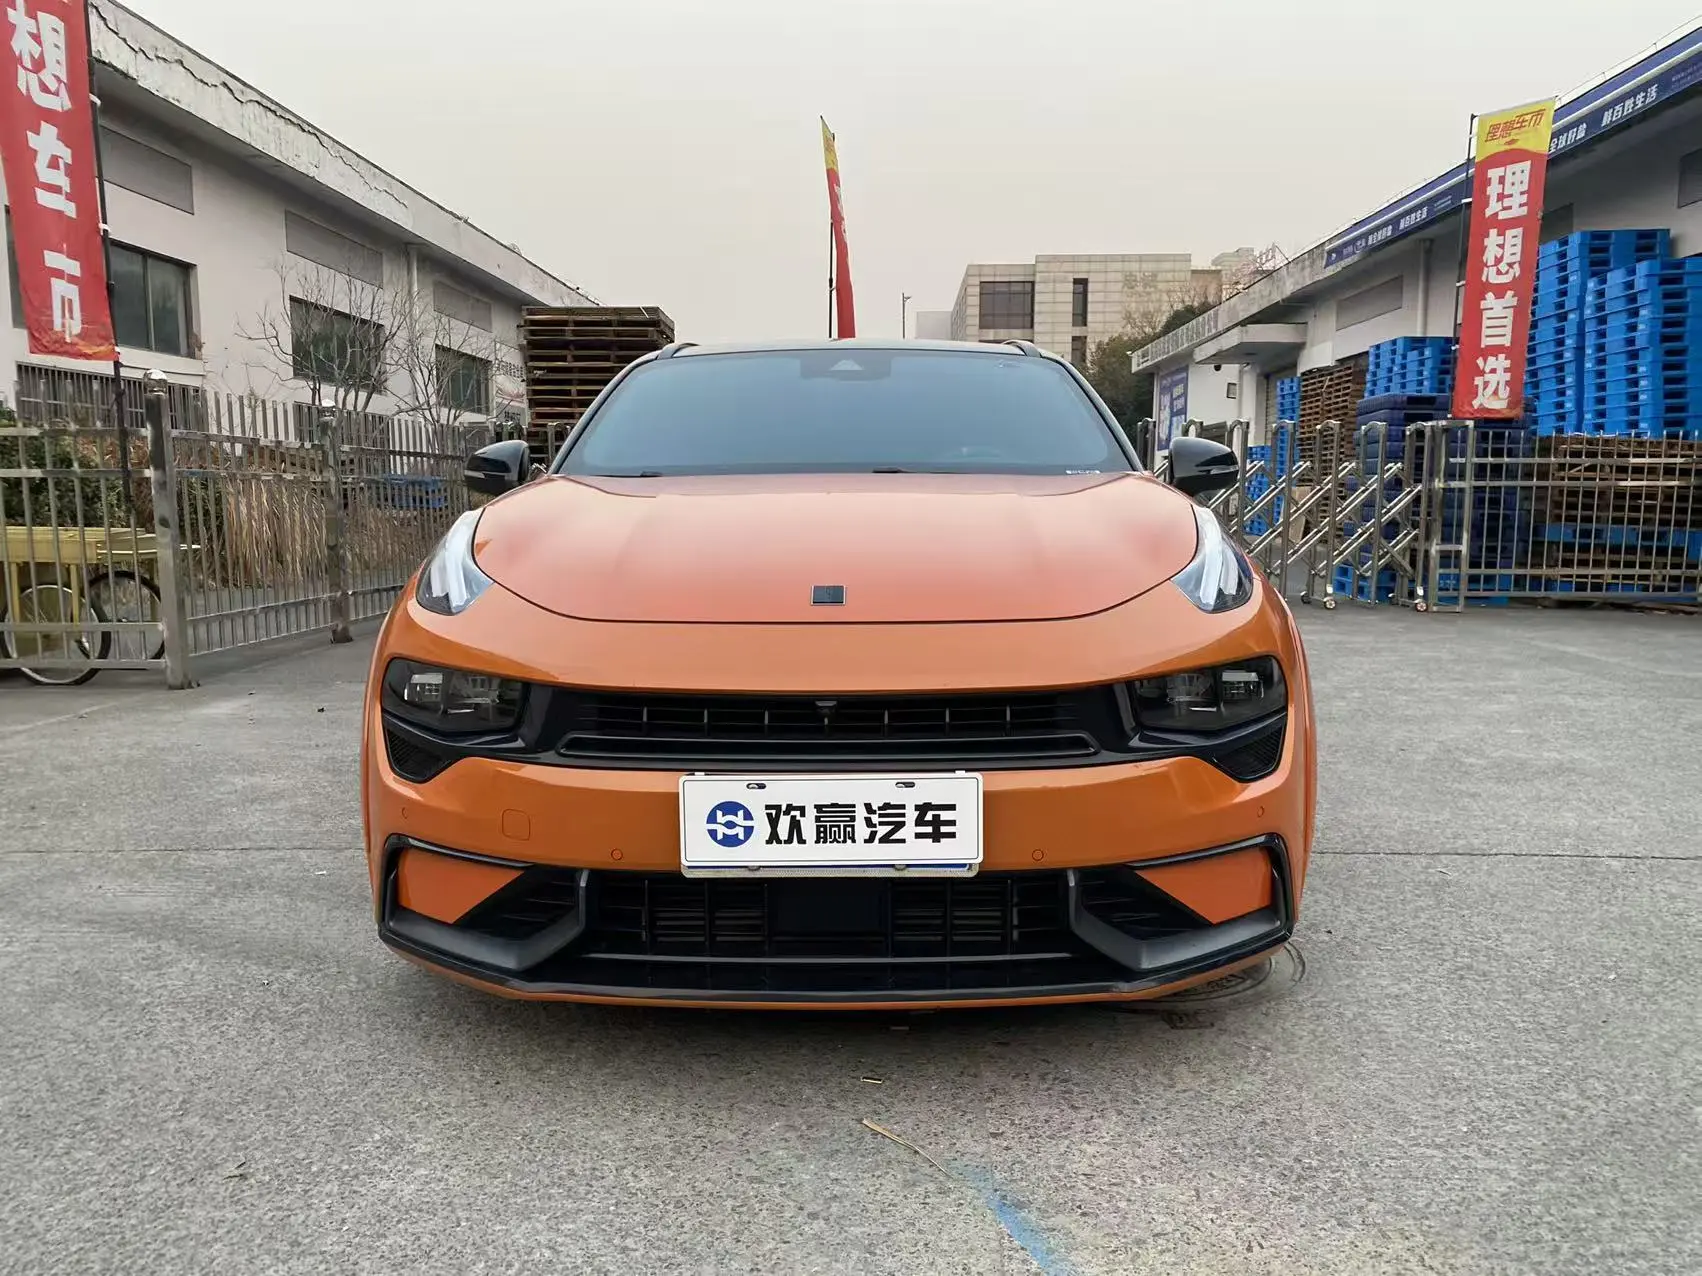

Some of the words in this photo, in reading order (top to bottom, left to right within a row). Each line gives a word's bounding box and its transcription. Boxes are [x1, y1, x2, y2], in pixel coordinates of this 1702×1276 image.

[1471, 159, 1532, 411] 理想首选
[764, 801, 957, 845] 欢赢汽车
